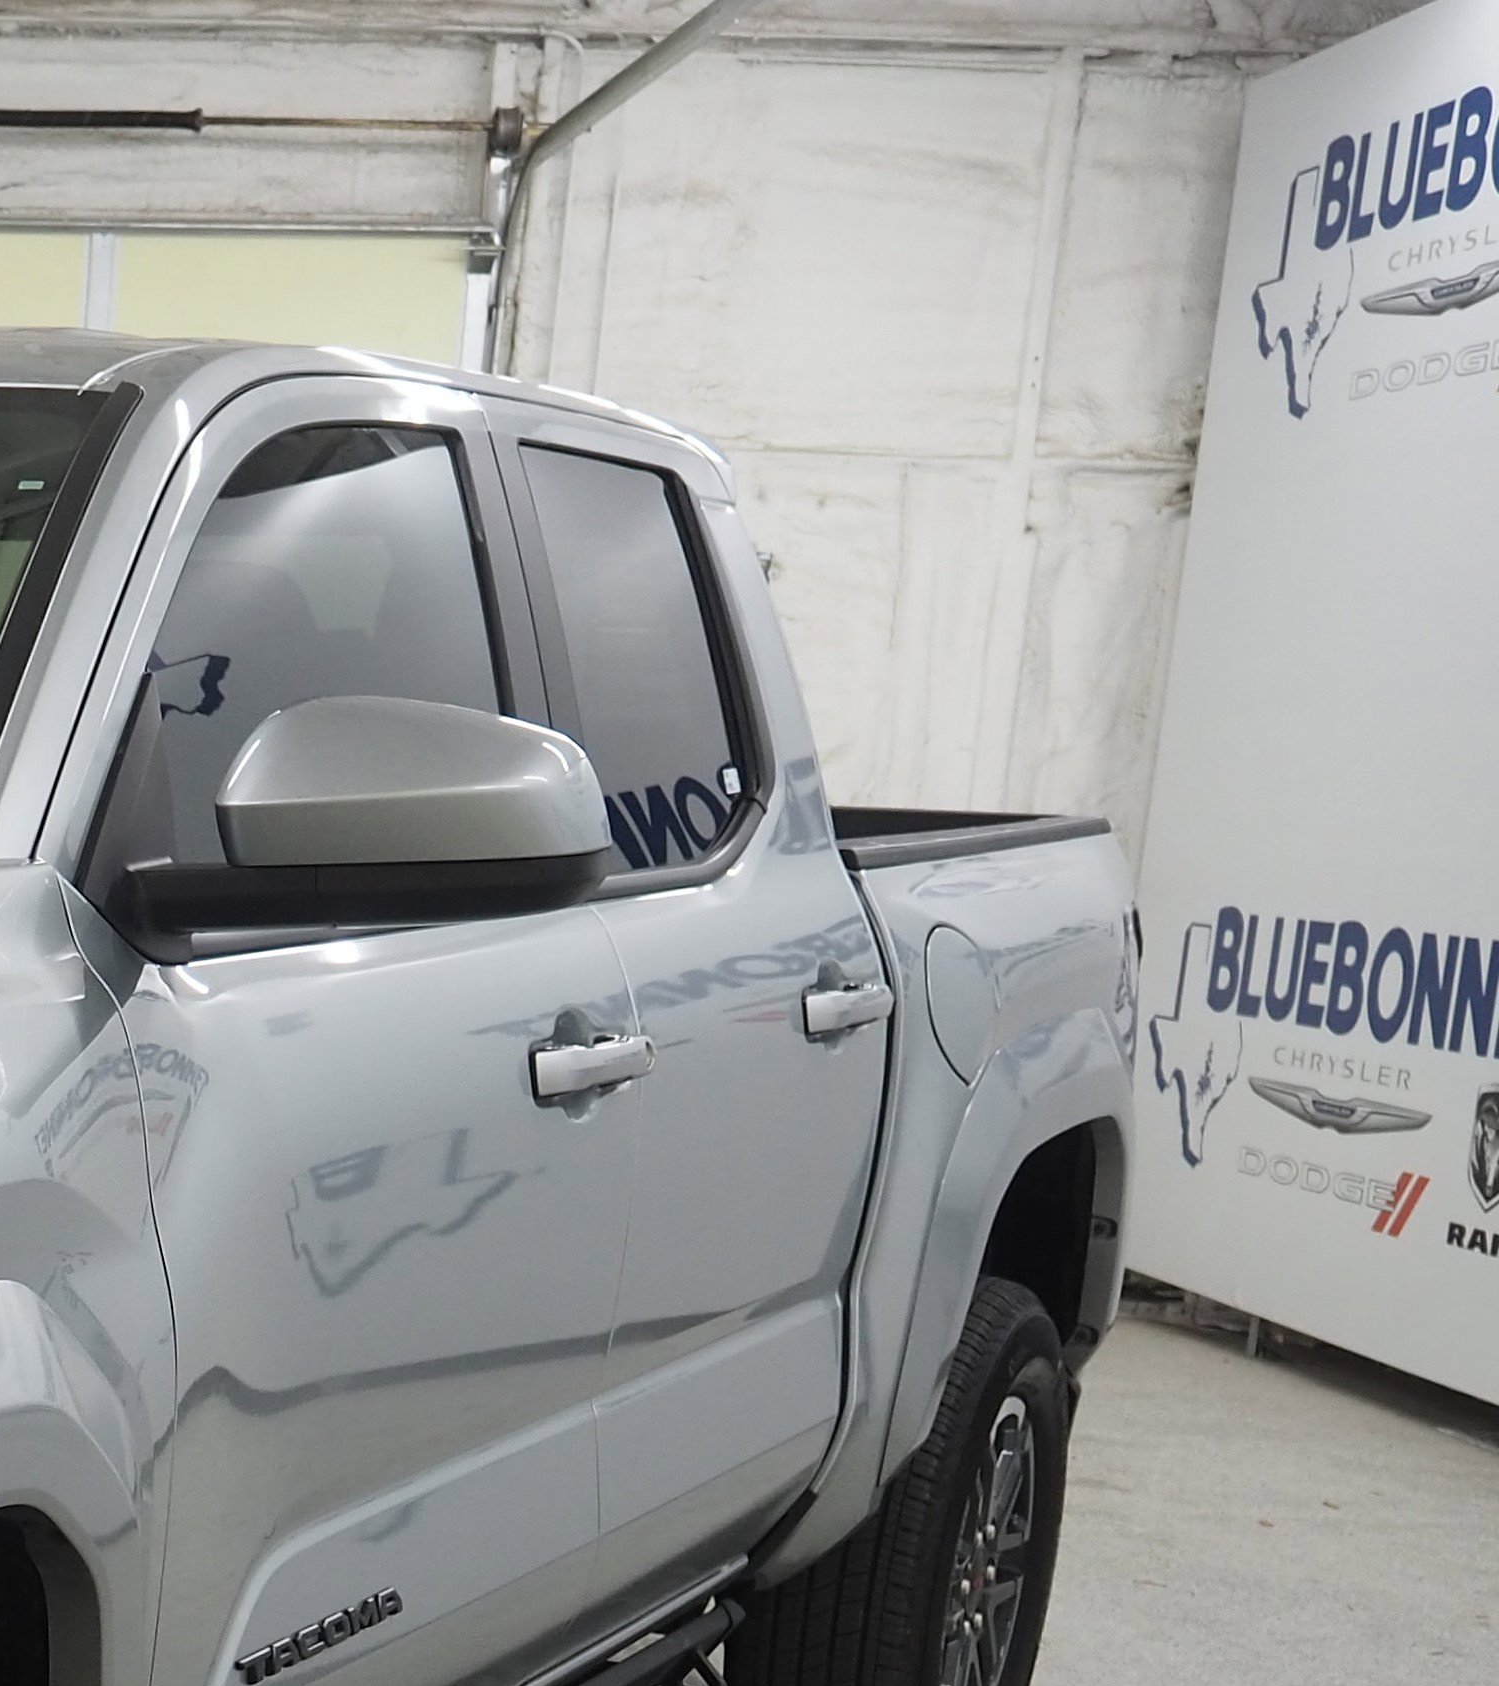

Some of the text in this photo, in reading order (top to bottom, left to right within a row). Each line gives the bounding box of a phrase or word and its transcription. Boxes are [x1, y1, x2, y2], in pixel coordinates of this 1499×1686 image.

[1315, 86, 1499, 251] BLUEB
[1207, 906, 1499, 1059] BLUEBONN
[1273, 1047, 1412, 1089] CHRYSLER
[1238, 1146, 1397, 1211] DODGE
[235, 1586, 403, 1685] TACOMA
